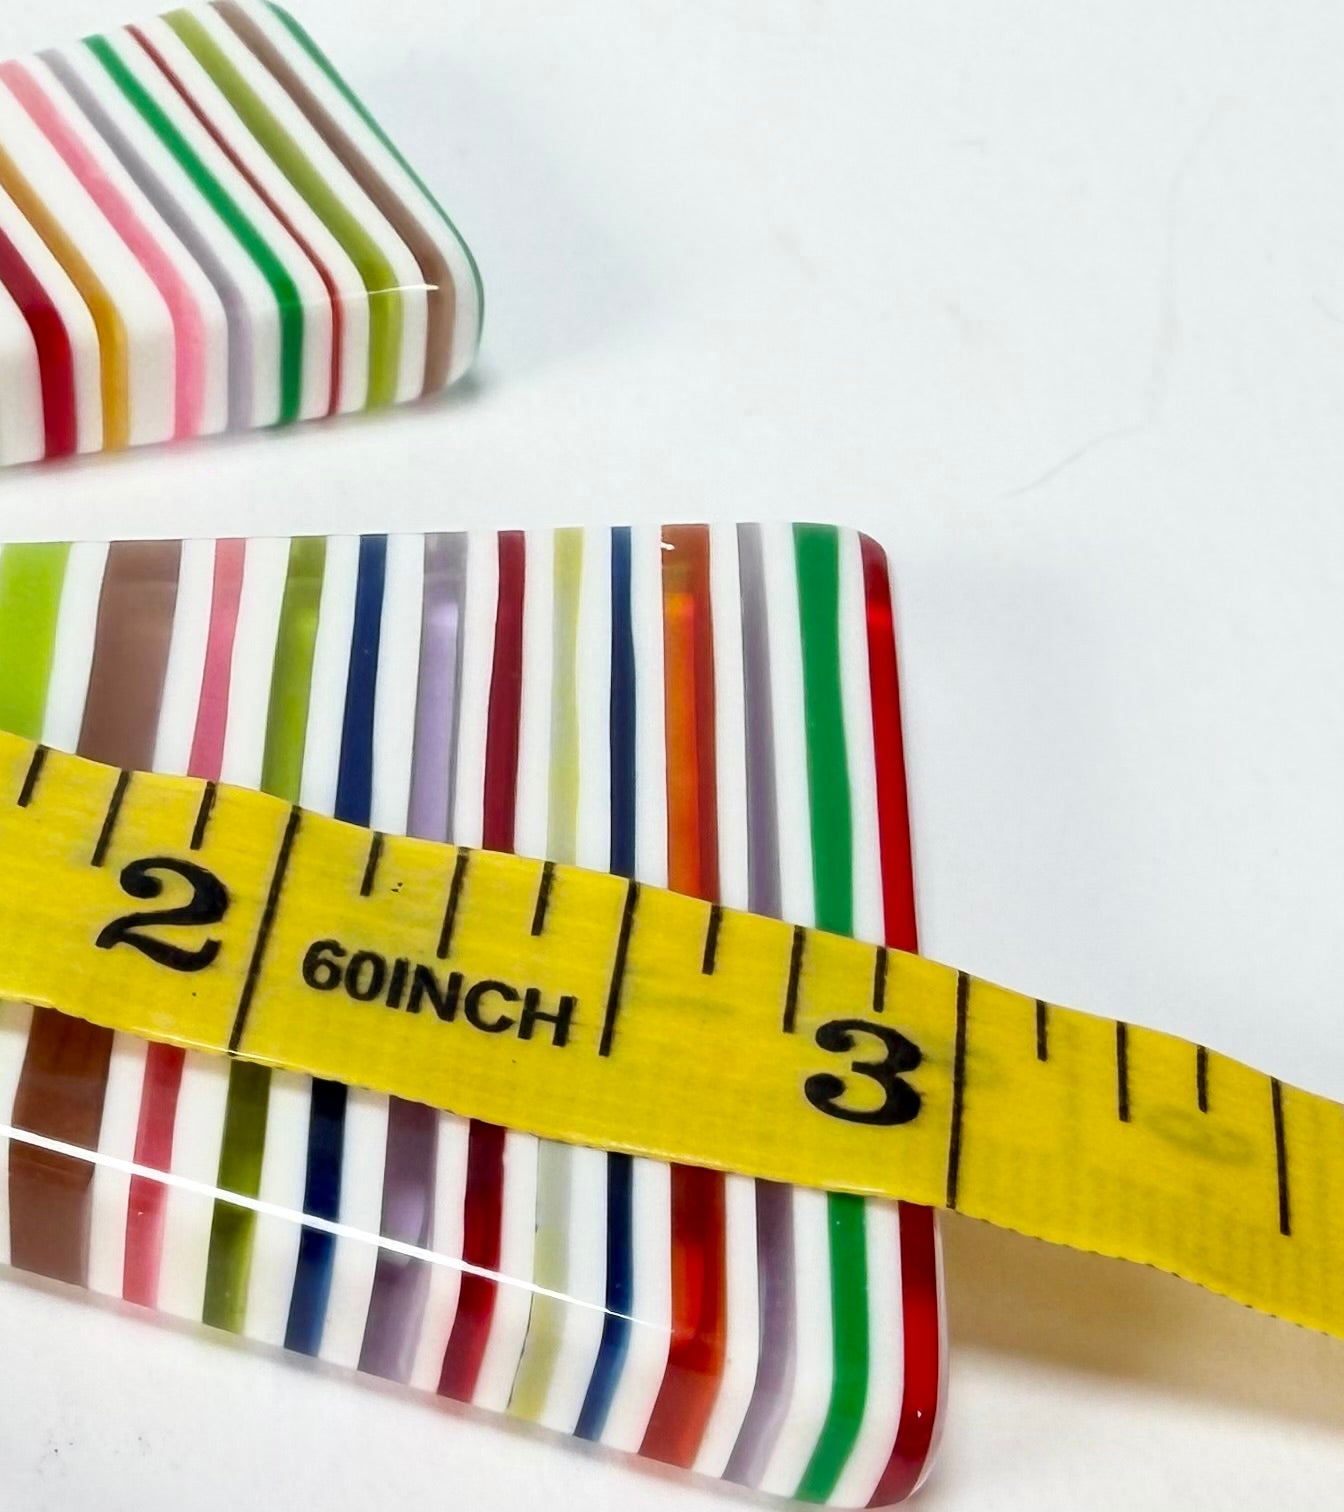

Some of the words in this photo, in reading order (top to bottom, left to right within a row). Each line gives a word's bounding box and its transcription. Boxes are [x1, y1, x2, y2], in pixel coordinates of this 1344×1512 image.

[94, 855, 233, 974] 2
[301, 938, 578, 1048] 60INCH
[803, 1018, 928, 1128] 3
